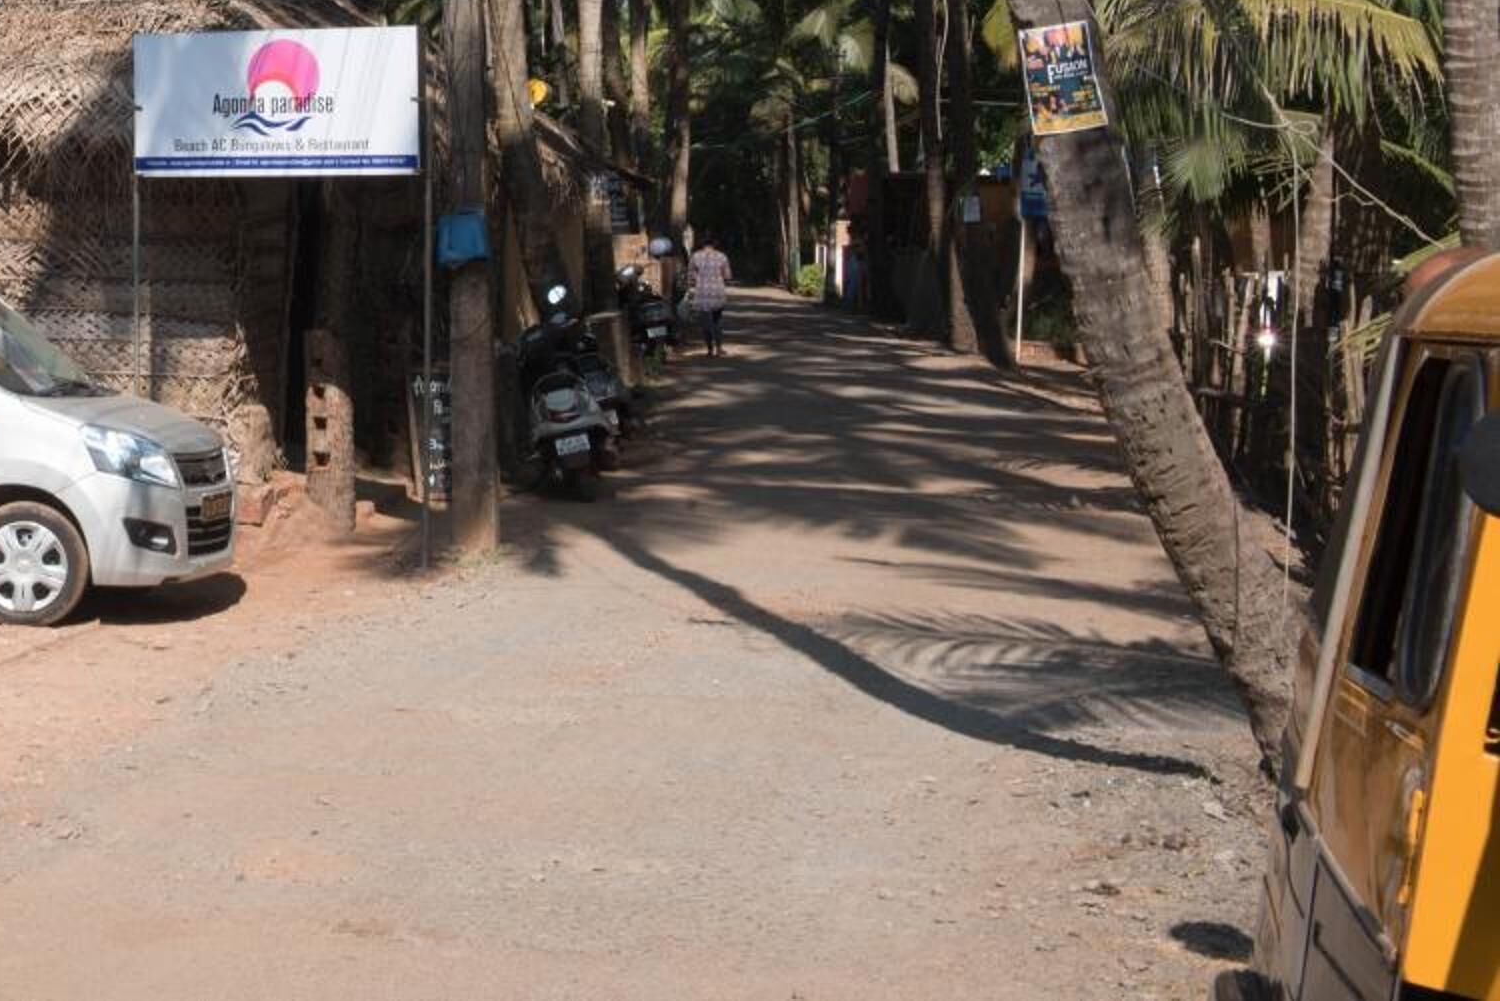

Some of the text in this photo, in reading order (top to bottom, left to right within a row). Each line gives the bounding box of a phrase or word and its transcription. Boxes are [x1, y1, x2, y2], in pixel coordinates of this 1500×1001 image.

[212, 92, 334, 118] Agonda paradise
[173, 138, 208, 152] Beach
[211, 137, 228, 151] AC
[294, 138, 305, 151] &
